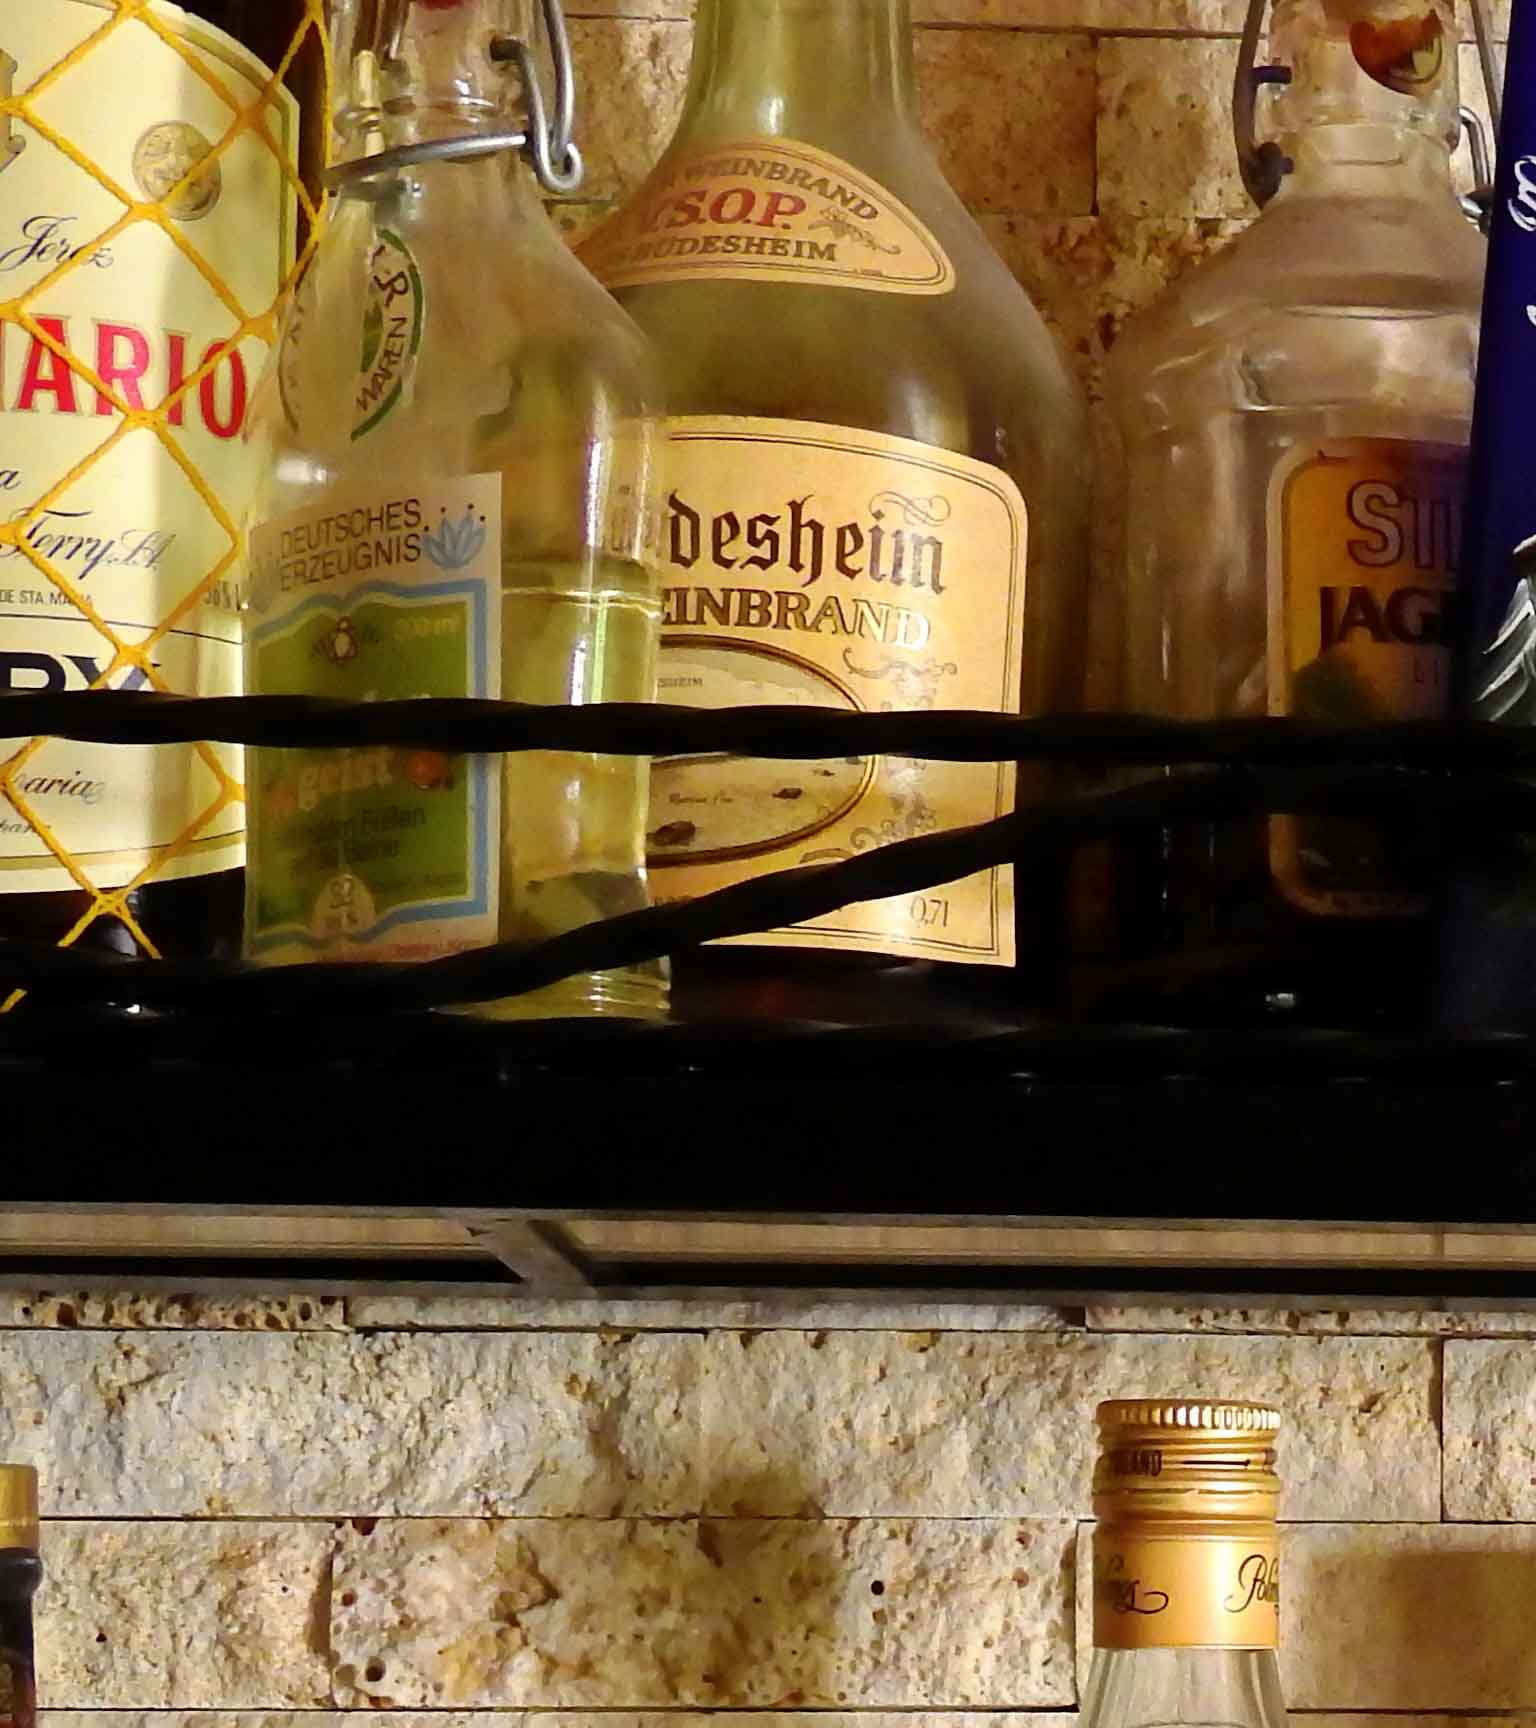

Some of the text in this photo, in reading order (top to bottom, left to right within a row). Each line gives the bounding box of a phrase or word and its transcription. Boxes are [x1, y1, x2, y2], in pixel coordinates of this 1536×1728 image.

[0, 313, 247, 438] ARIO
[281, 498, 421, 559] DEUTSCHES
[281, 533, 422, 591] ERZEUGNIS
